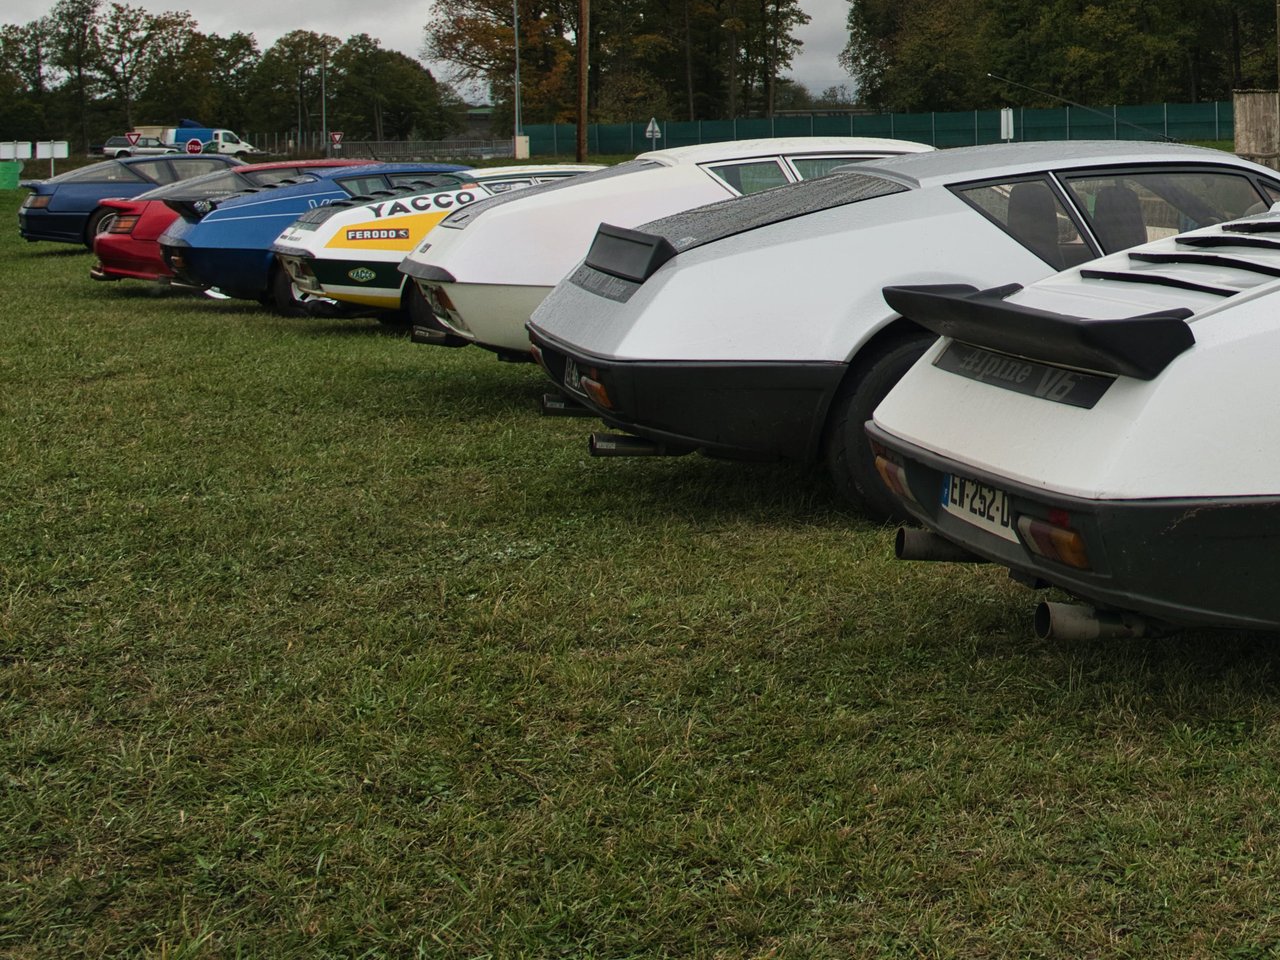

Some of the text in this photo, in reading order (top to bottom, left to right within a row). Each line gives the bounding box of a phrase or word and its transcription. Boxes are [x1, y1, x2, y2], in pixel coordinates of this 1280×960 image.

[366, 191, 475, 218] YACCO
[348, 230, 396, 240] FERODO
[960, 349, 1076, 400] Alpine V6
